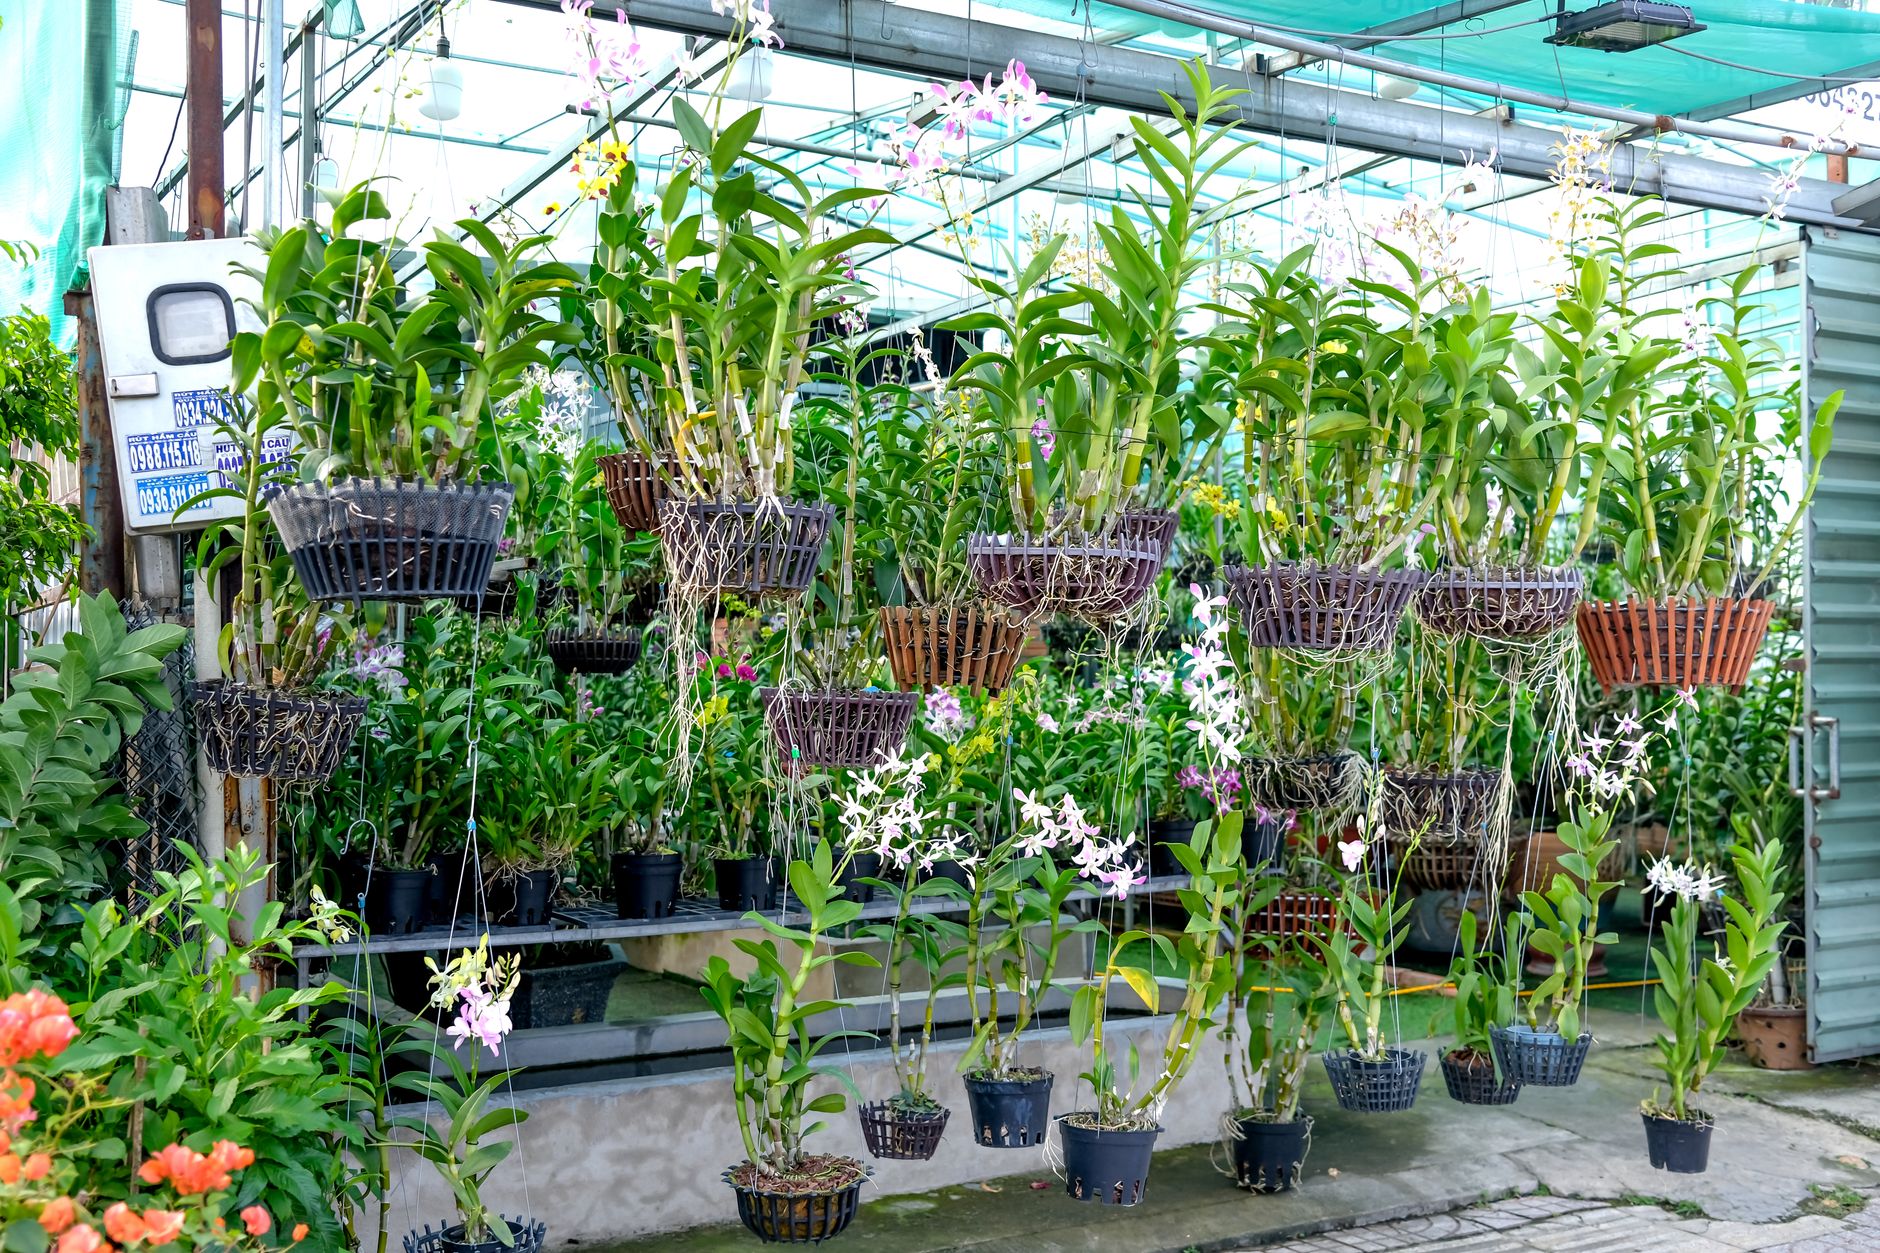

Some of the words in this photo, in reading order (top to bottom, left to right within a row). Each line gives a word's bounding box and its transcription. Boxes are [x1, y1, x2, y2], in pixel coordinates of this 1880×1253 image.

[175, 398, 243, 427] 0934.224.
[130, 440, 201, 471] 0988.115.118
[139, 483, 210, 514] 0936.811855
